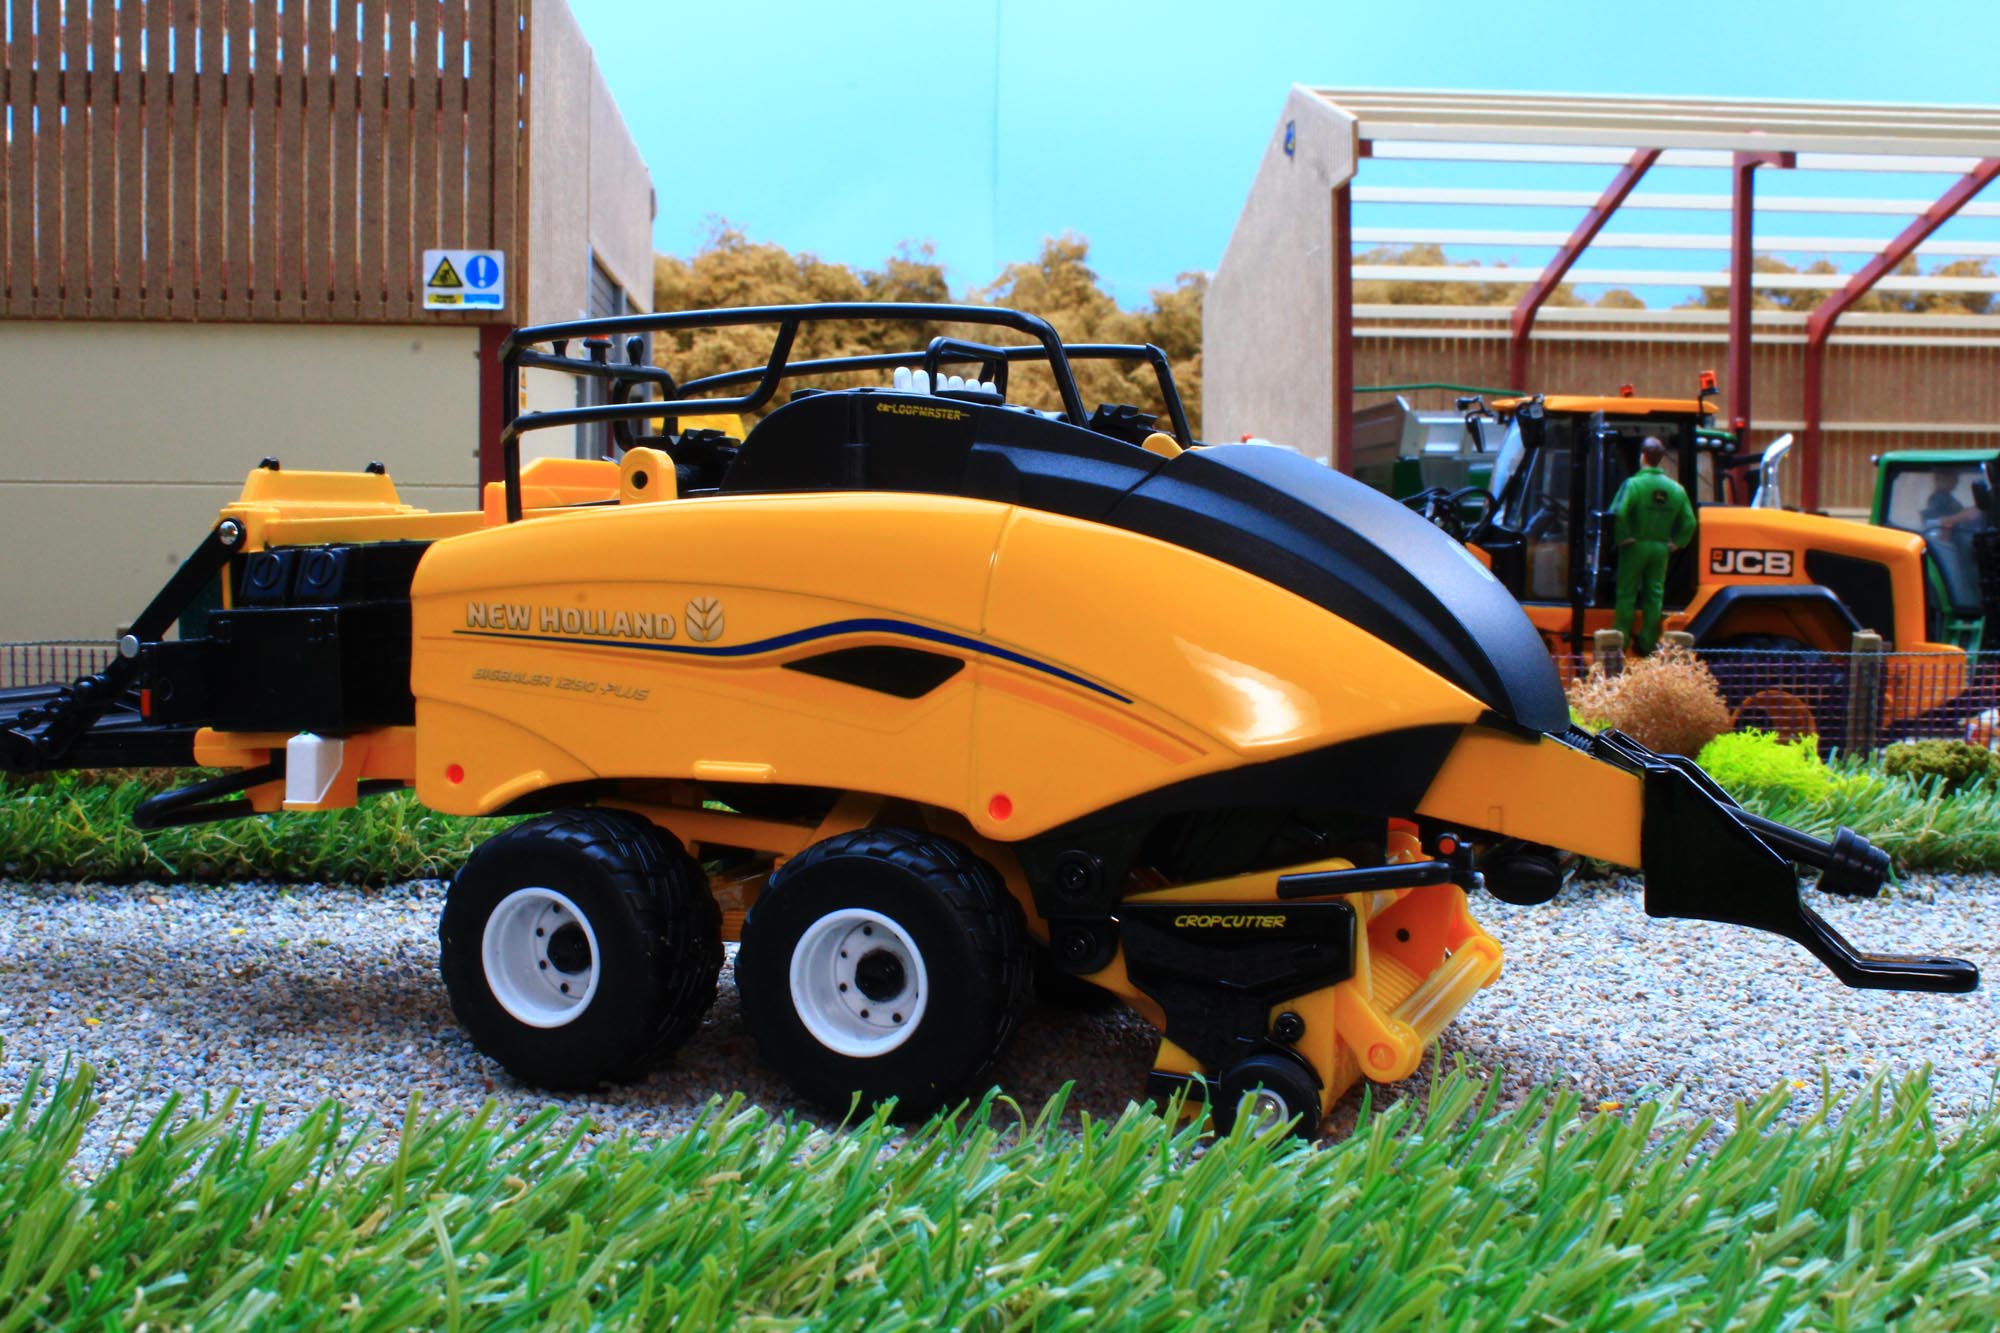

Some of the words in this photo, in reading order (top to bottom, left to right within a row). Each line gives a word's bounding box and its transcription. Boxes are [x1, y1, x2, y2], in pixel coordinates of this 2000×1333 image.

[1712, 550, 1792, 575] JCB
[467, 601, 531, 630] NEW
[540, 606, 676, 639] HOLLAND
[472, 667, 553, 687] BIGBALER
[555, 676, 598, 693] 1290
[1174, 914, 1287, 928] CROPCUTTER
